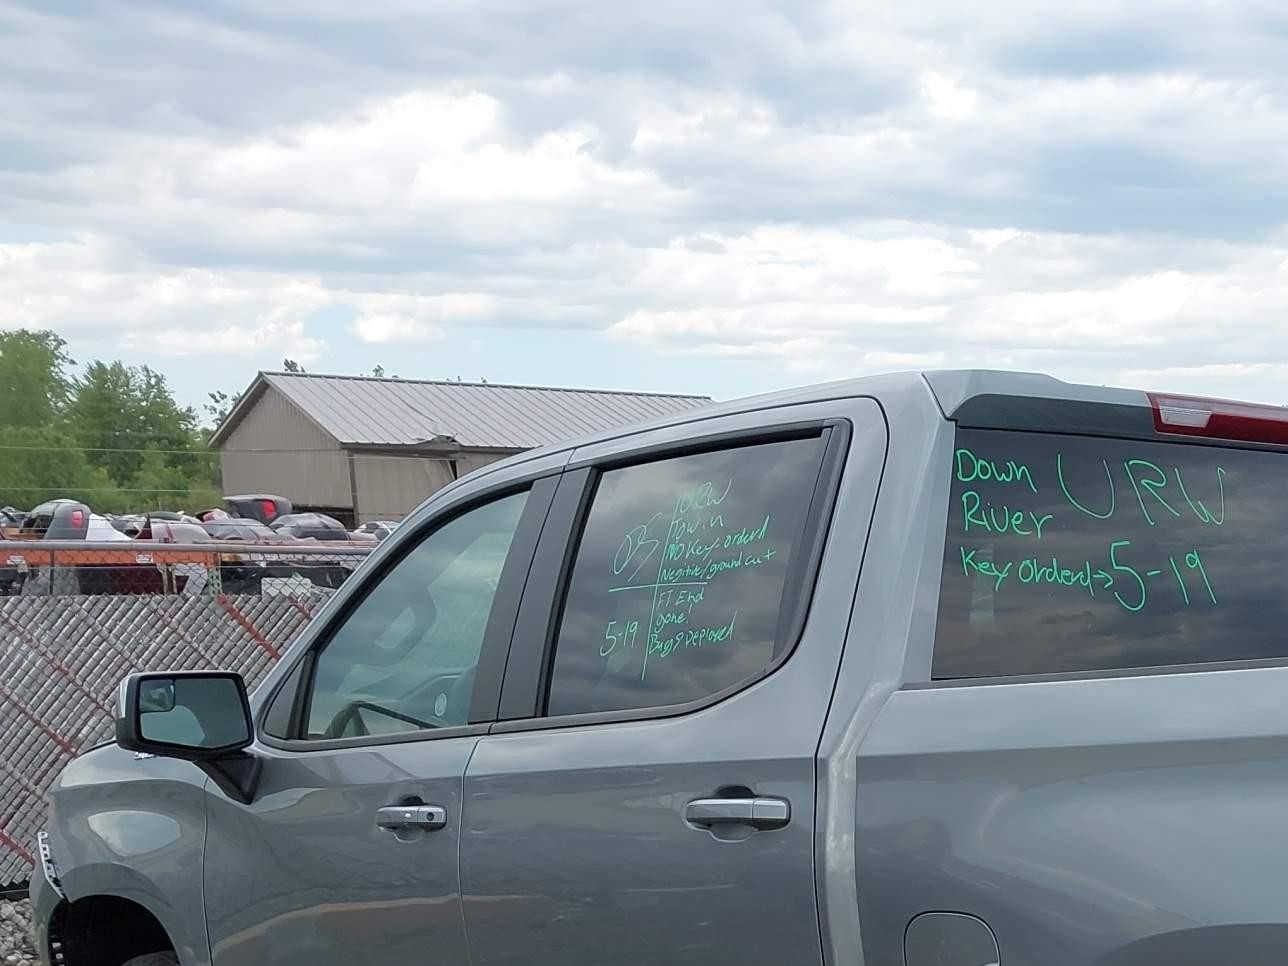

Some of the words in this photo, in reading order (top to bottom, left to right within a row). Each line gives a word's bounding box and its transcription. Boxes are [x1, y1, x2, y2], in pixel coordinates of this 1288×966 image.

[956, 448, 1038, 494] Down
[1057, 451, 1227, 526] URW
[961, 491, 1053, 539] River
[960, 546, 1012, 591] Key
[1110, 540, 1217, 612] 5-19
[599, 620, 639, 657] 5-19
